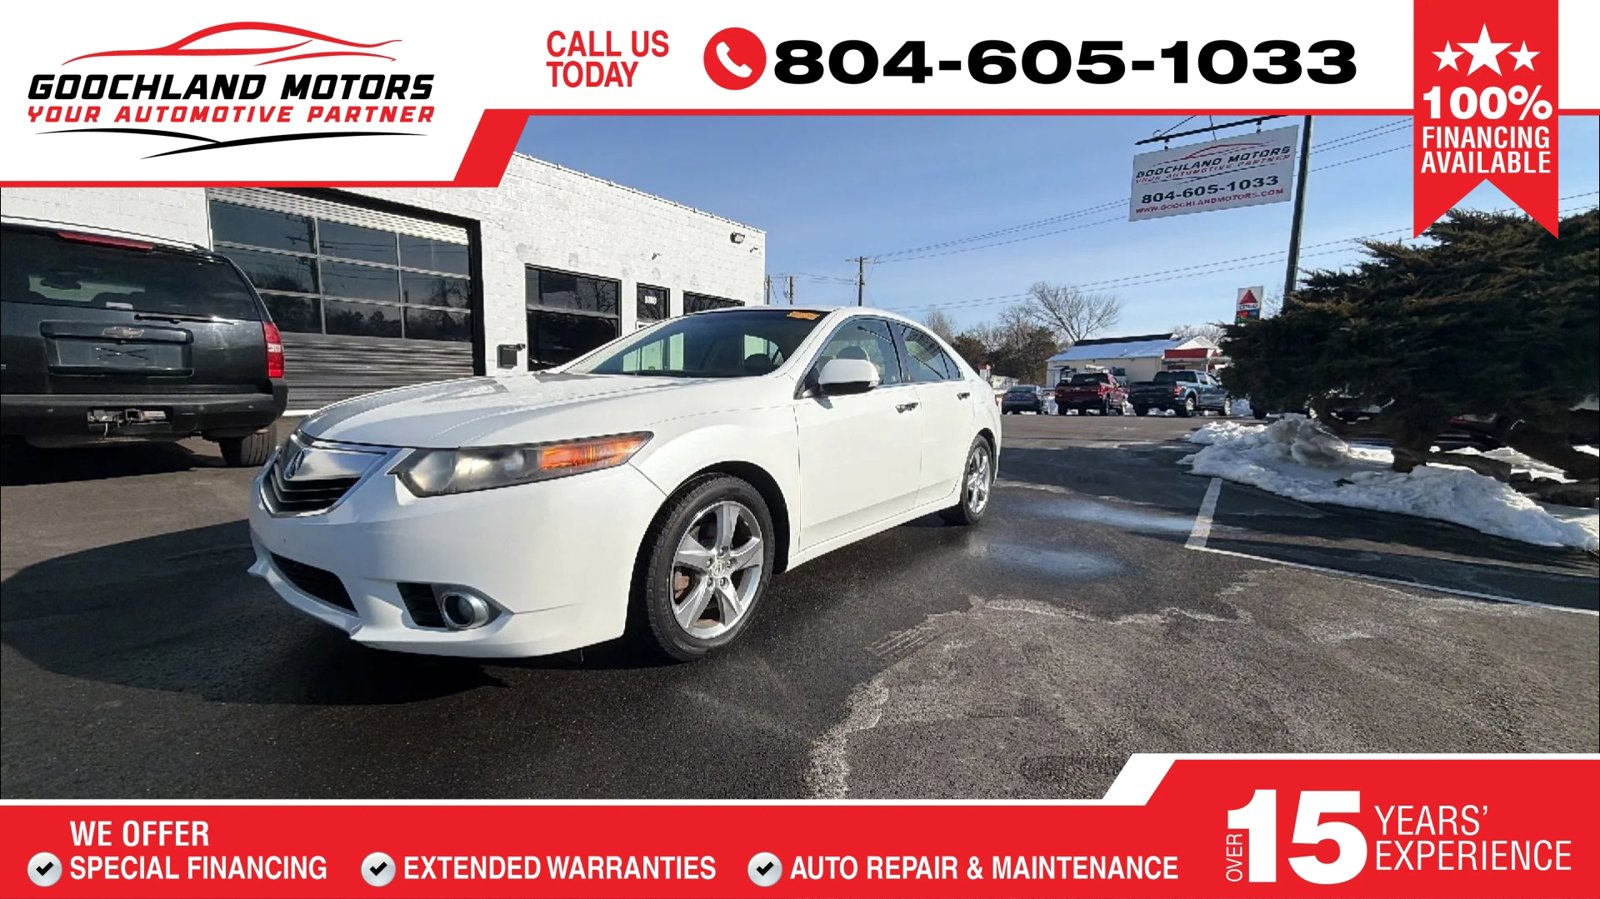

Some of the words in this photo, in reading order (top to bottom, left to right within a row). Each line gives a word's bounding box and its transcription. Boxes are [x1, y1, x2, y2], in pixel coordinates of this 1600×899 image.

[1136, 157, 1222, 179] GOOCHLAND
[1228, 146, 1291, 163] MOTORS
[1135, 187, 1284, 214] WWW.GOOCHLANDMOTORS.COM
[1141, 175, 1279, 204] 804-605-1033
